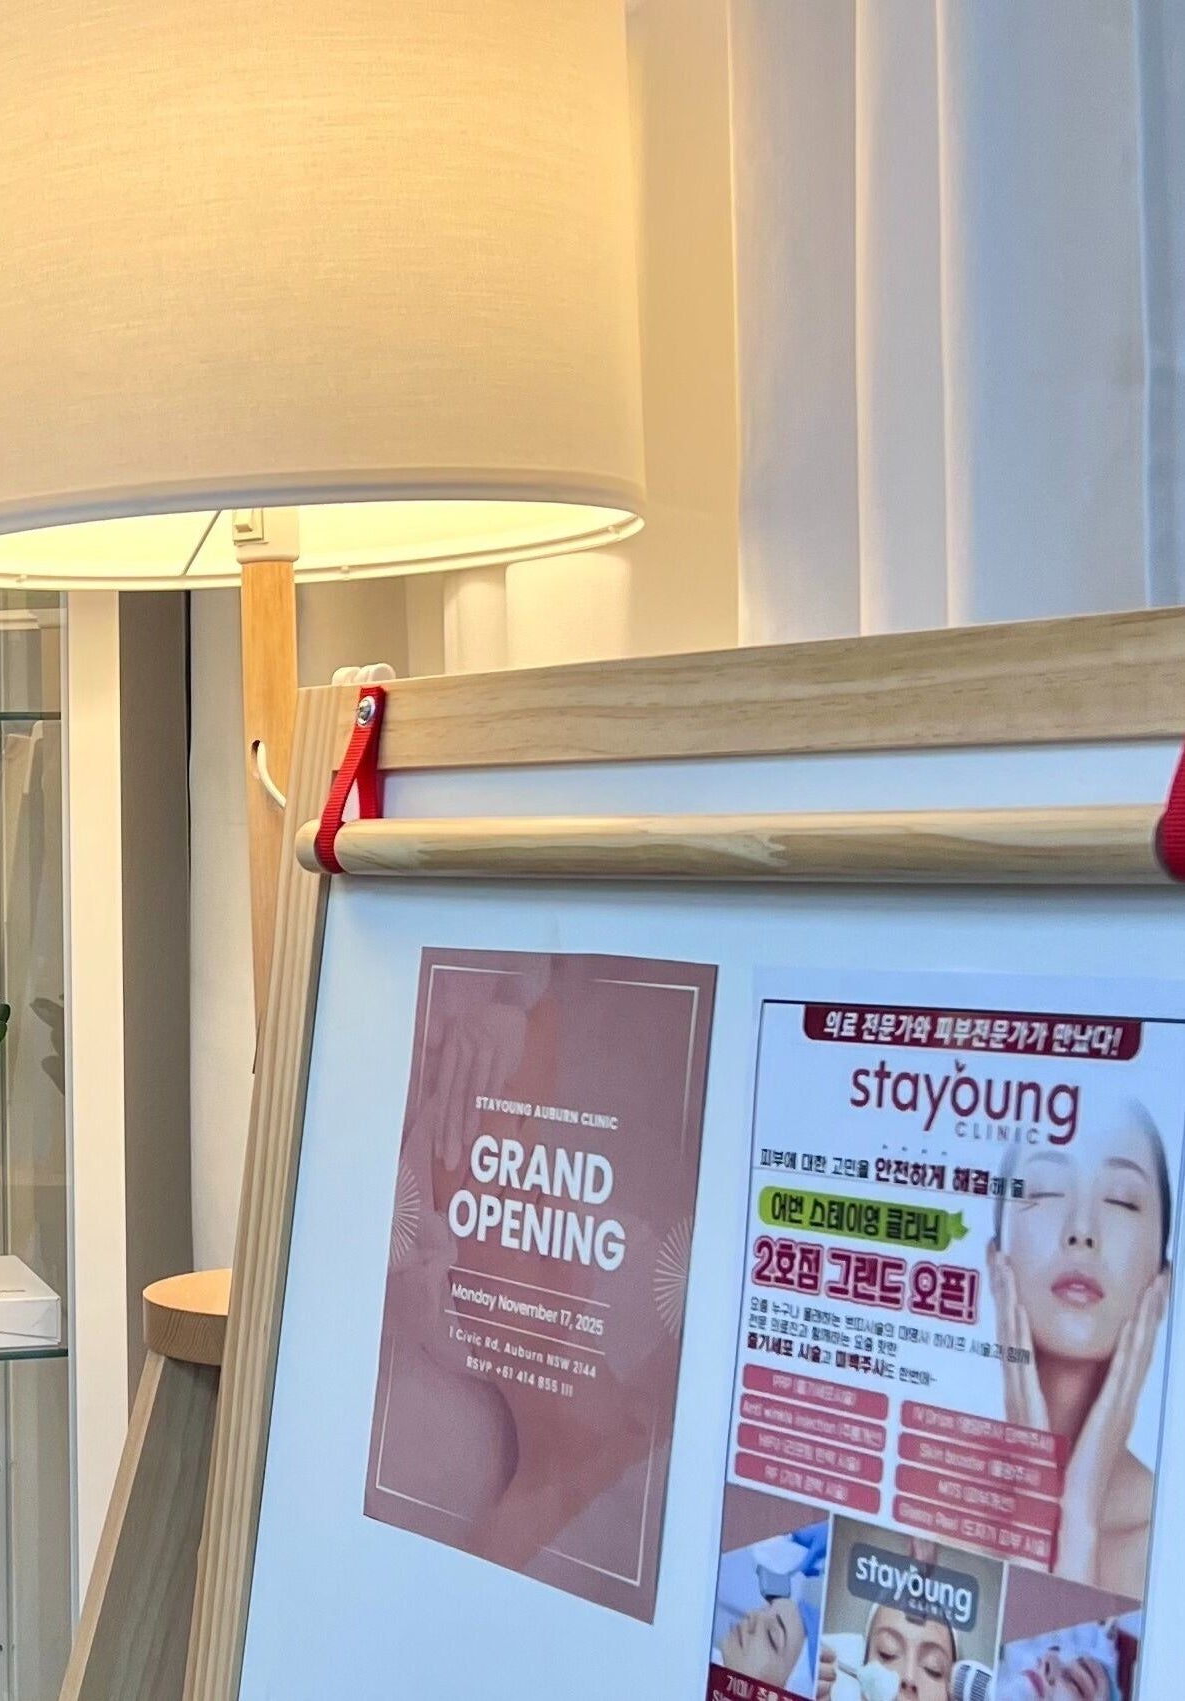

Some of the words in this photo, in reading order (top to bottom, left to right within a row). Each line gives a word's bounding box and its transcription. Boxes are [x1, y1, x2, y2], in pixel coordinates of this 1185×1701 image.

[823, 1010, 859, 1039] 의료
[861, 1012, 932, 1044] 전문가와
[933, 1015, 1049, 1052] 피부전문가가
[1051, 1021, 1124, 1056] 만났다!
[475, 1095, 533, 1117] STAYOUNG
[533, 1104, 579, 1125] AUBURN
[580, 1112, 619, 1131] CLINIC
[849, 1060, 1080, 1146] stayoung
[954, 1120, 1041, 1145] CLINIC
[470, 1134, 614, 1205] GRAND
[760, 1147, 797, 1170] 피부에
[801, 1152, 827, 1174] 대한
[831, 1156, 869, 1180] 고민을
[874, 1156, 947, 1191] 안전하게
[448, 1189, 626, 1271] OPENING
[771, 1190, 804, 1225] 어번
[808, 1196, 882, 1238] 스테이영
[885, 1207, 941, 1246] 클리닉
[754, 1235, 822, 1294] 2호점
[910, 1263, 978, 1321] 오픈!
[450, 1282, 498, 1312] Monday
[498, 1294, 558, 1324] November
[575, 1313, 605, 1337] 2025
[772, 1302, 800, 1319] 누구나
[455, 1328, 483, 1347] Civic
[503, 1341, 544, 1365] Auburn
[546, 1353, 571, 1371] NSW
[572, 1360, 597, 1379] 2144
[747, 1331, 794, 1357] 줄기세포
[466, 1355, 493, 1373] RSVP
[495, 1365, 514, 1380] +61
[516, 1369, 535, 1386] 414
[537, 1375, 559, 1393] 855
[855, 1554, 973, 1623] stayoung
